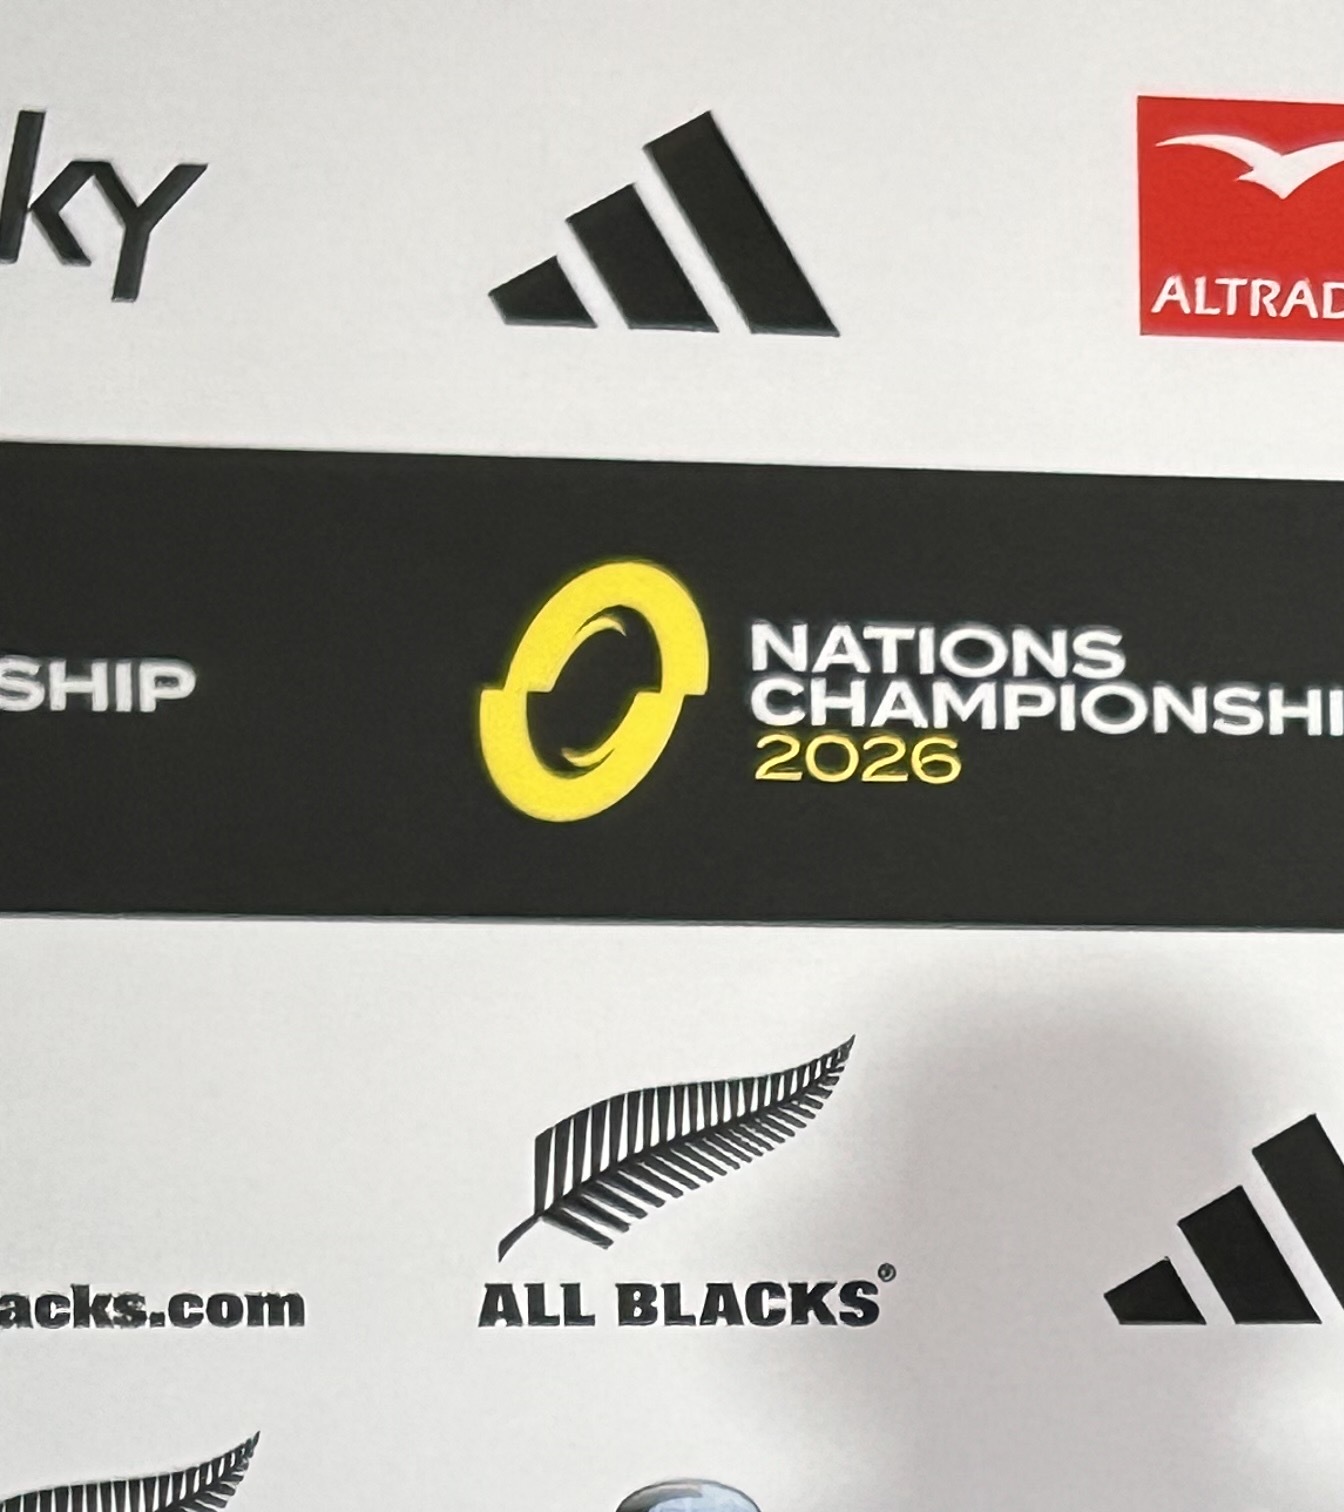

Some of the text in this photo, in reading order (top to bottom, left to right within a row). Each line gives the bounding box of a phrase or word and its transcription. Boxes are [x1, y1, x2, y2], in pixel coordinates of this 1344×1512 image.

[751, 623, 1126, 677] NATIONS
[755, 733, 962, 784] 2026
[477, 1279, 880, 1328] ALL BLACKS
